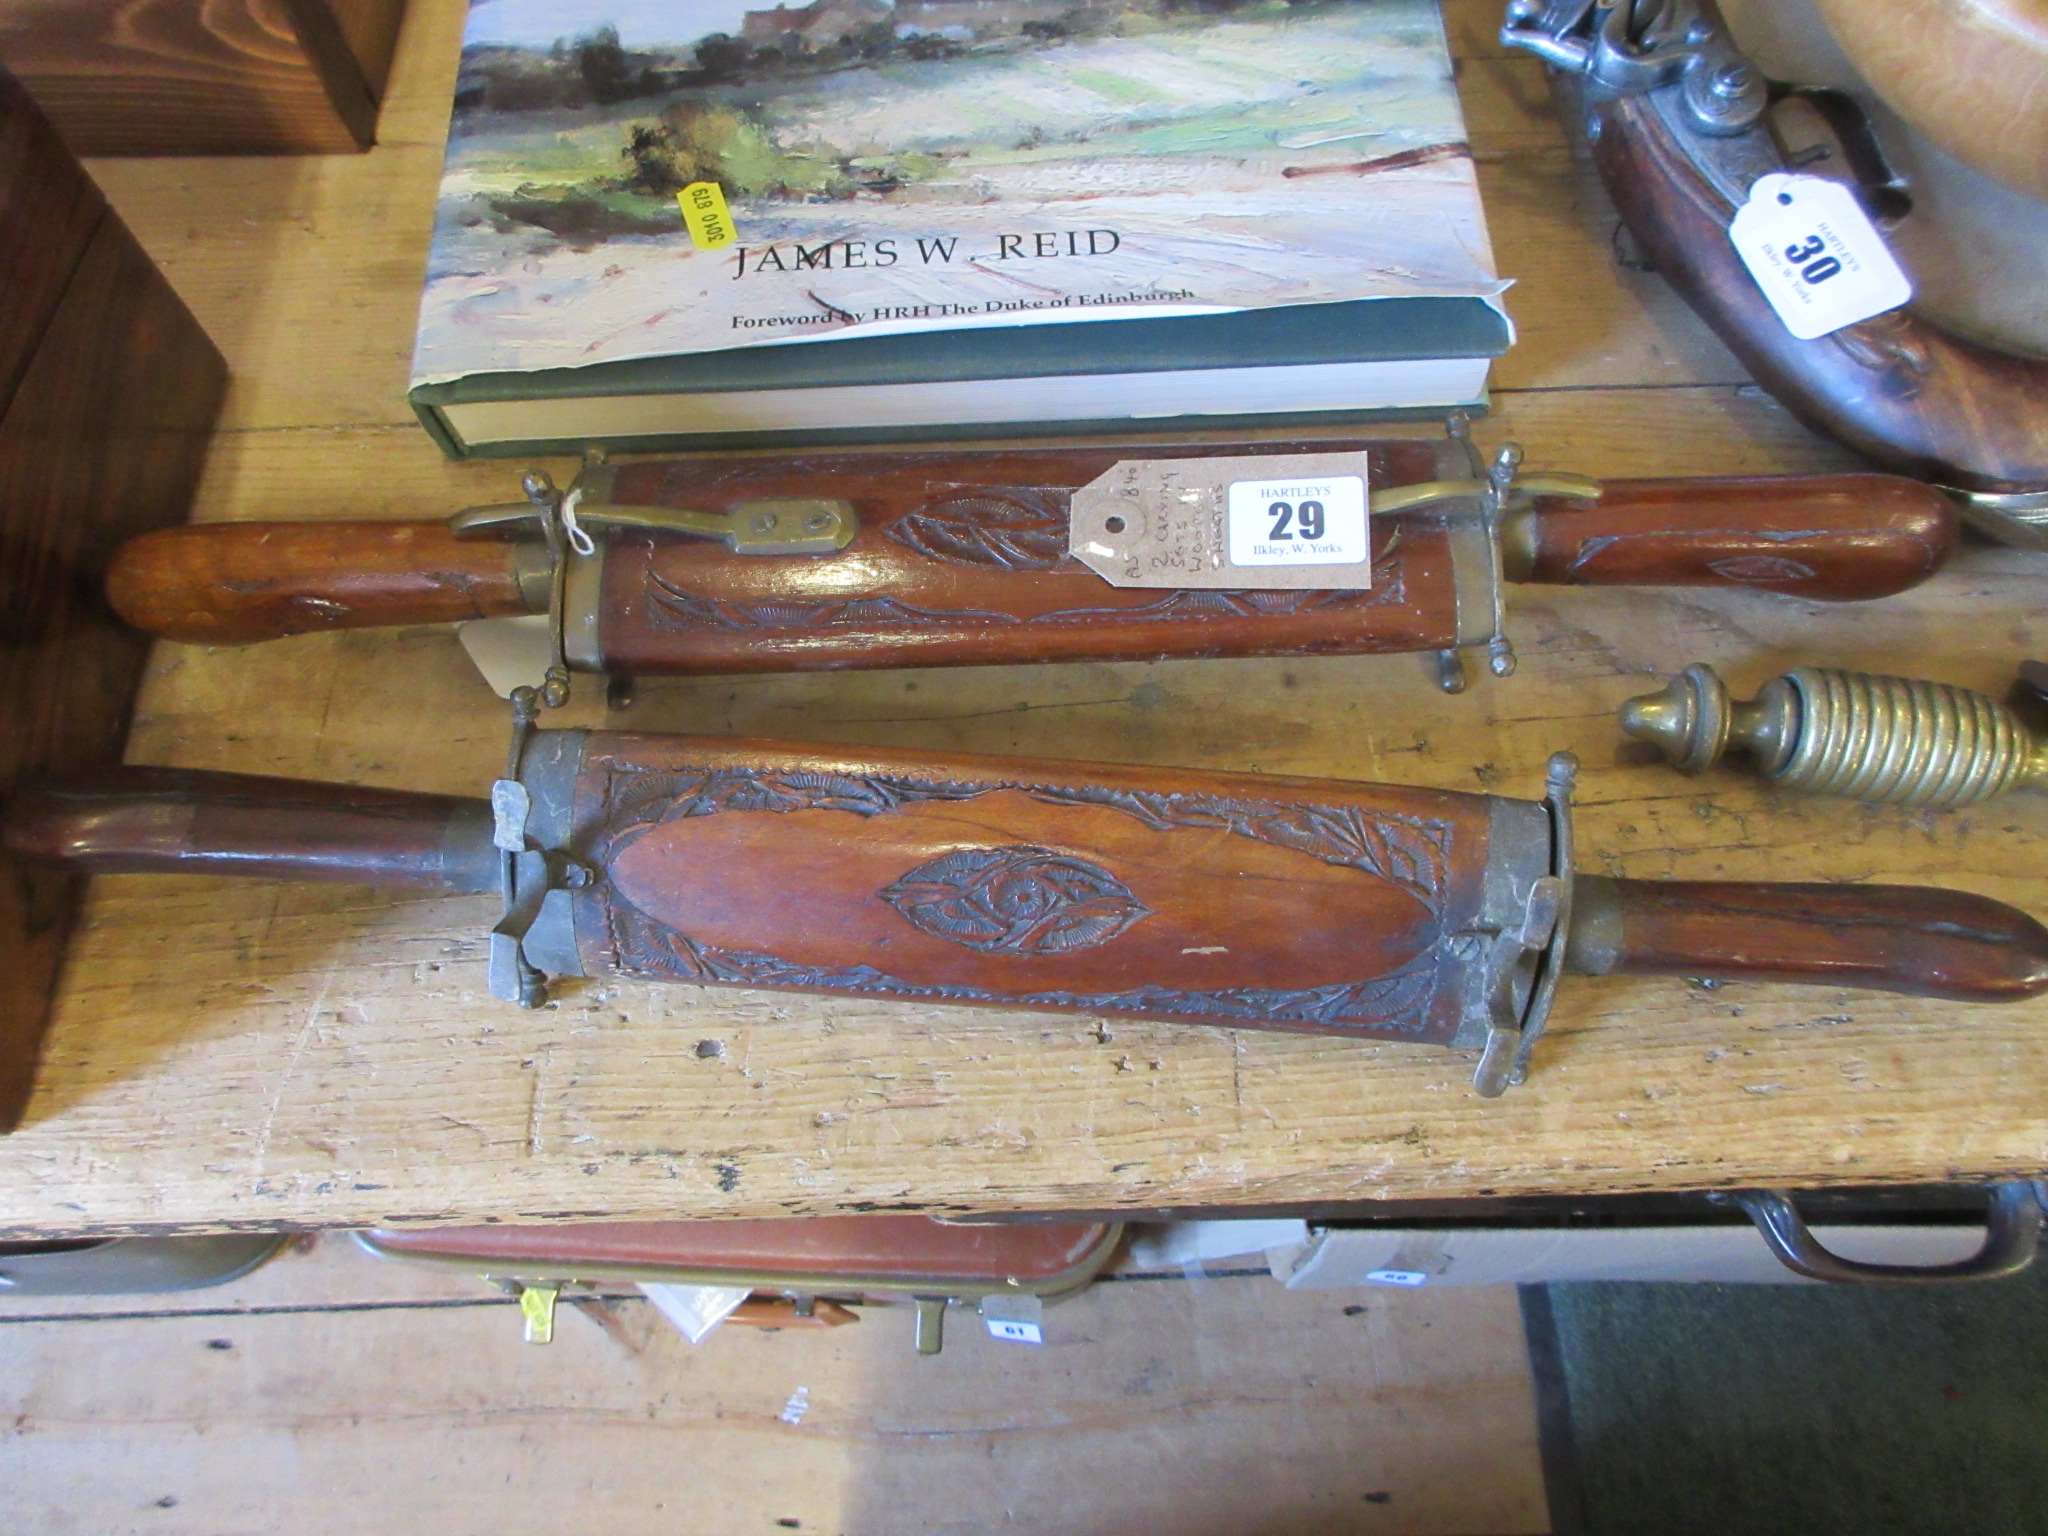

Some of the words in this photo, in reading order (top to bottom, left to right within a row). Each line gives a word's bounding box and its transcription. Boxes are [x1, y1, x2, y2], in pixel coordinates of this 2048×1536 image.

[692, 188, 714, 210] 879
[702, 213, 726, 243] 3010
[1816, 222, 1862, 273] HARTLEYS
[732, 239, 899, 280] JAMES
[916, 237, 977, 265] W.
[998, 229, 1122, 261] REID
[1784, 234, 1842, 286] 30
[731, 310, 834, 330] Foreword
[840, 308, 867, 325] by
[873, 304, 932, 320] HRH
[937, 300, 980, 316] The
[985, 296, 1044, 313] Duke
[1050, 293, 1072, 309] of
[1078, 287, 1196, 307] Edinburgh
[1260, 486, 1331, 499] HARTLEYS
[1268, 500, 1326, 541] 29
[1253, 543, 1290, 558] Ilkley,
[1292, 545, 1309, 555] W.
[1310, 543, 1343, 555] Yorks
